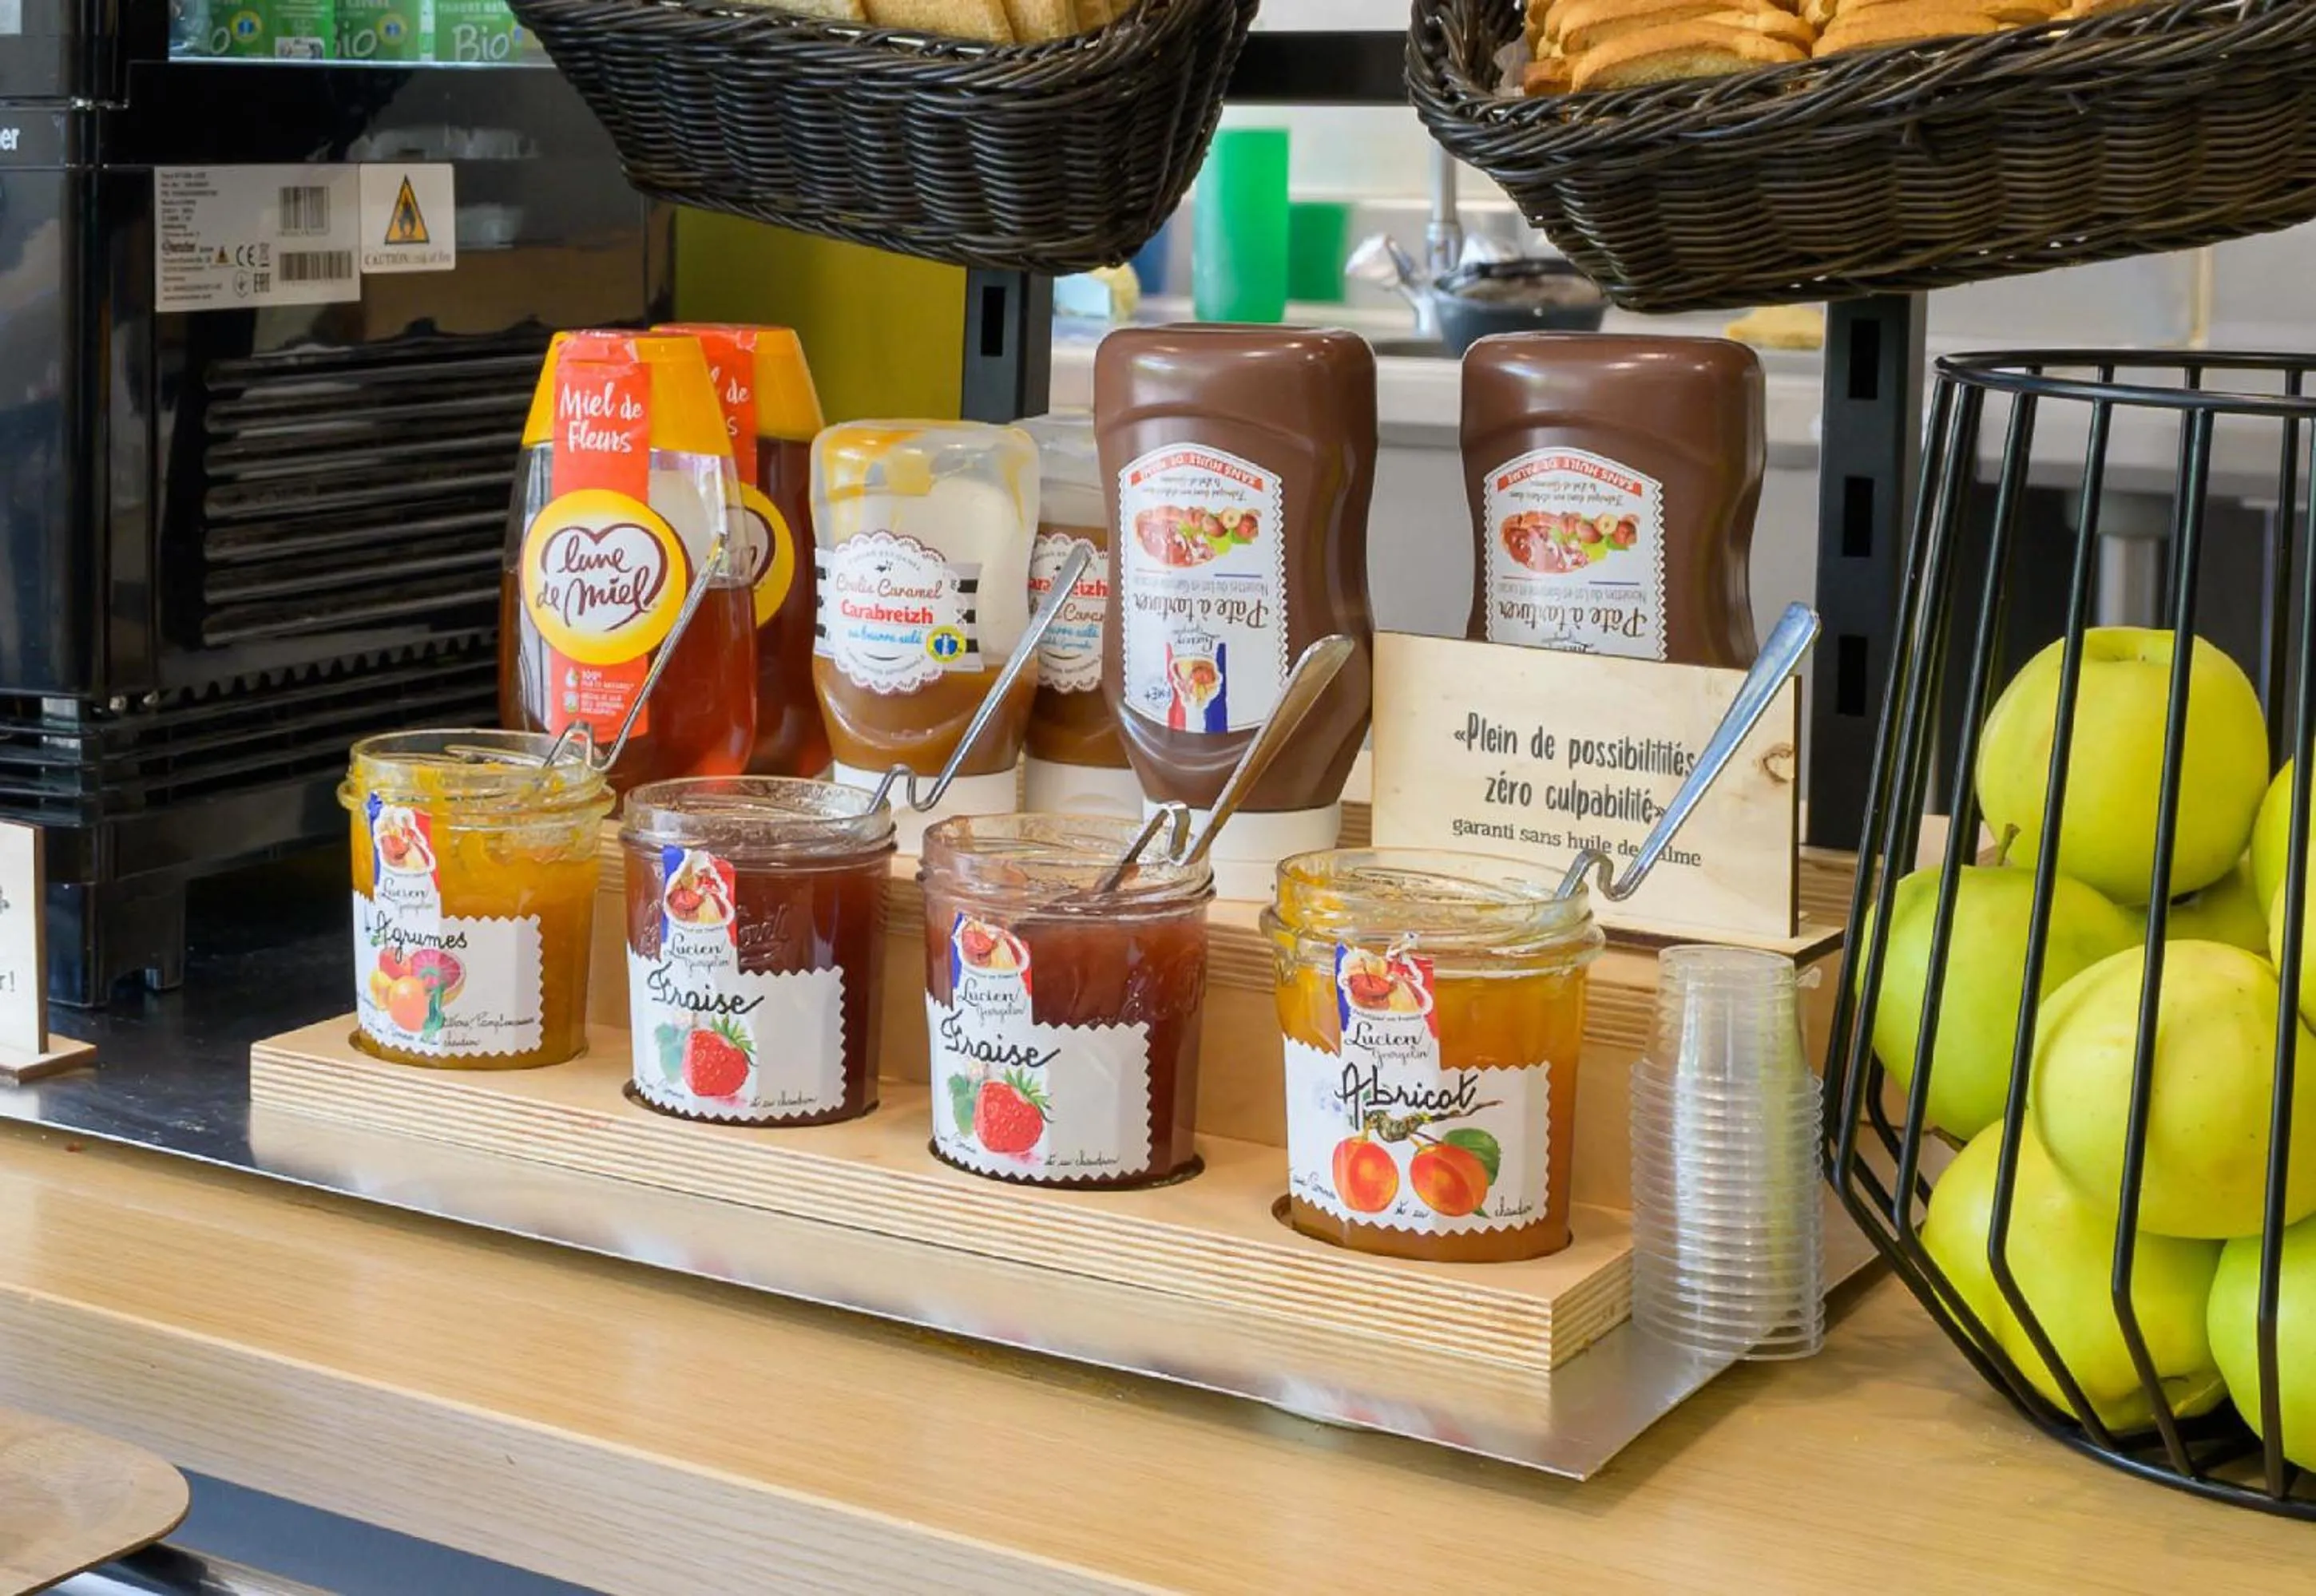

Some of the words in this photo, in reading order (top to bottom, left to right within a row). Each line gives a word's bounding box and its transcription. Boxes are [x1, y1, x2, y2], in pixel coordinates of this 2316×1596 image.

[452, 24, 510, 61] Bio
[560, 382, 615, 422] Miel
[620, 394, 642, 420] de
[725, 378, 749, 403] de
[568, 421, 633, 453] Fleurs
[557, 535, 633, 573] lune
[536, 581, 560, 609] de
[878, 578, 943, 600] Caramel
[840, 598, 934, 624] Carabreizh
[1133, 592, 1194, 624] tartiner
[1196, 598, 1212, 622] à
[1212, 598, 1269, 629] Pâte
[1497, 601, 1565, 632] tartiner
[1568, 607, 1584, 630] à
[1588, 606, 1648, 639] Pâte
[1453, 711, 1517, 754] «Plein
[1530, 726, 1556, 760] de
[1485, 770, 1533, 807] zéro
[1452, 818, 1514, 842] garanti
[1520, 826, 1562, 847] sans
[1567, 831, 1612, 854] huile
[1617, 840, 1640, 857] de
[373, 909, 469, 964] Agrumes
[664, 933, 726, 961] Lucien
[647, 960, 765, 1016] Fraise
[957, 977, 1021, 1008] Lucien
[940, 1009, 1061, 1067] Fraise
[1344, 1020, 1426, 1051] Lucien
[1334, 1062, 1479, 1131] Abricot
